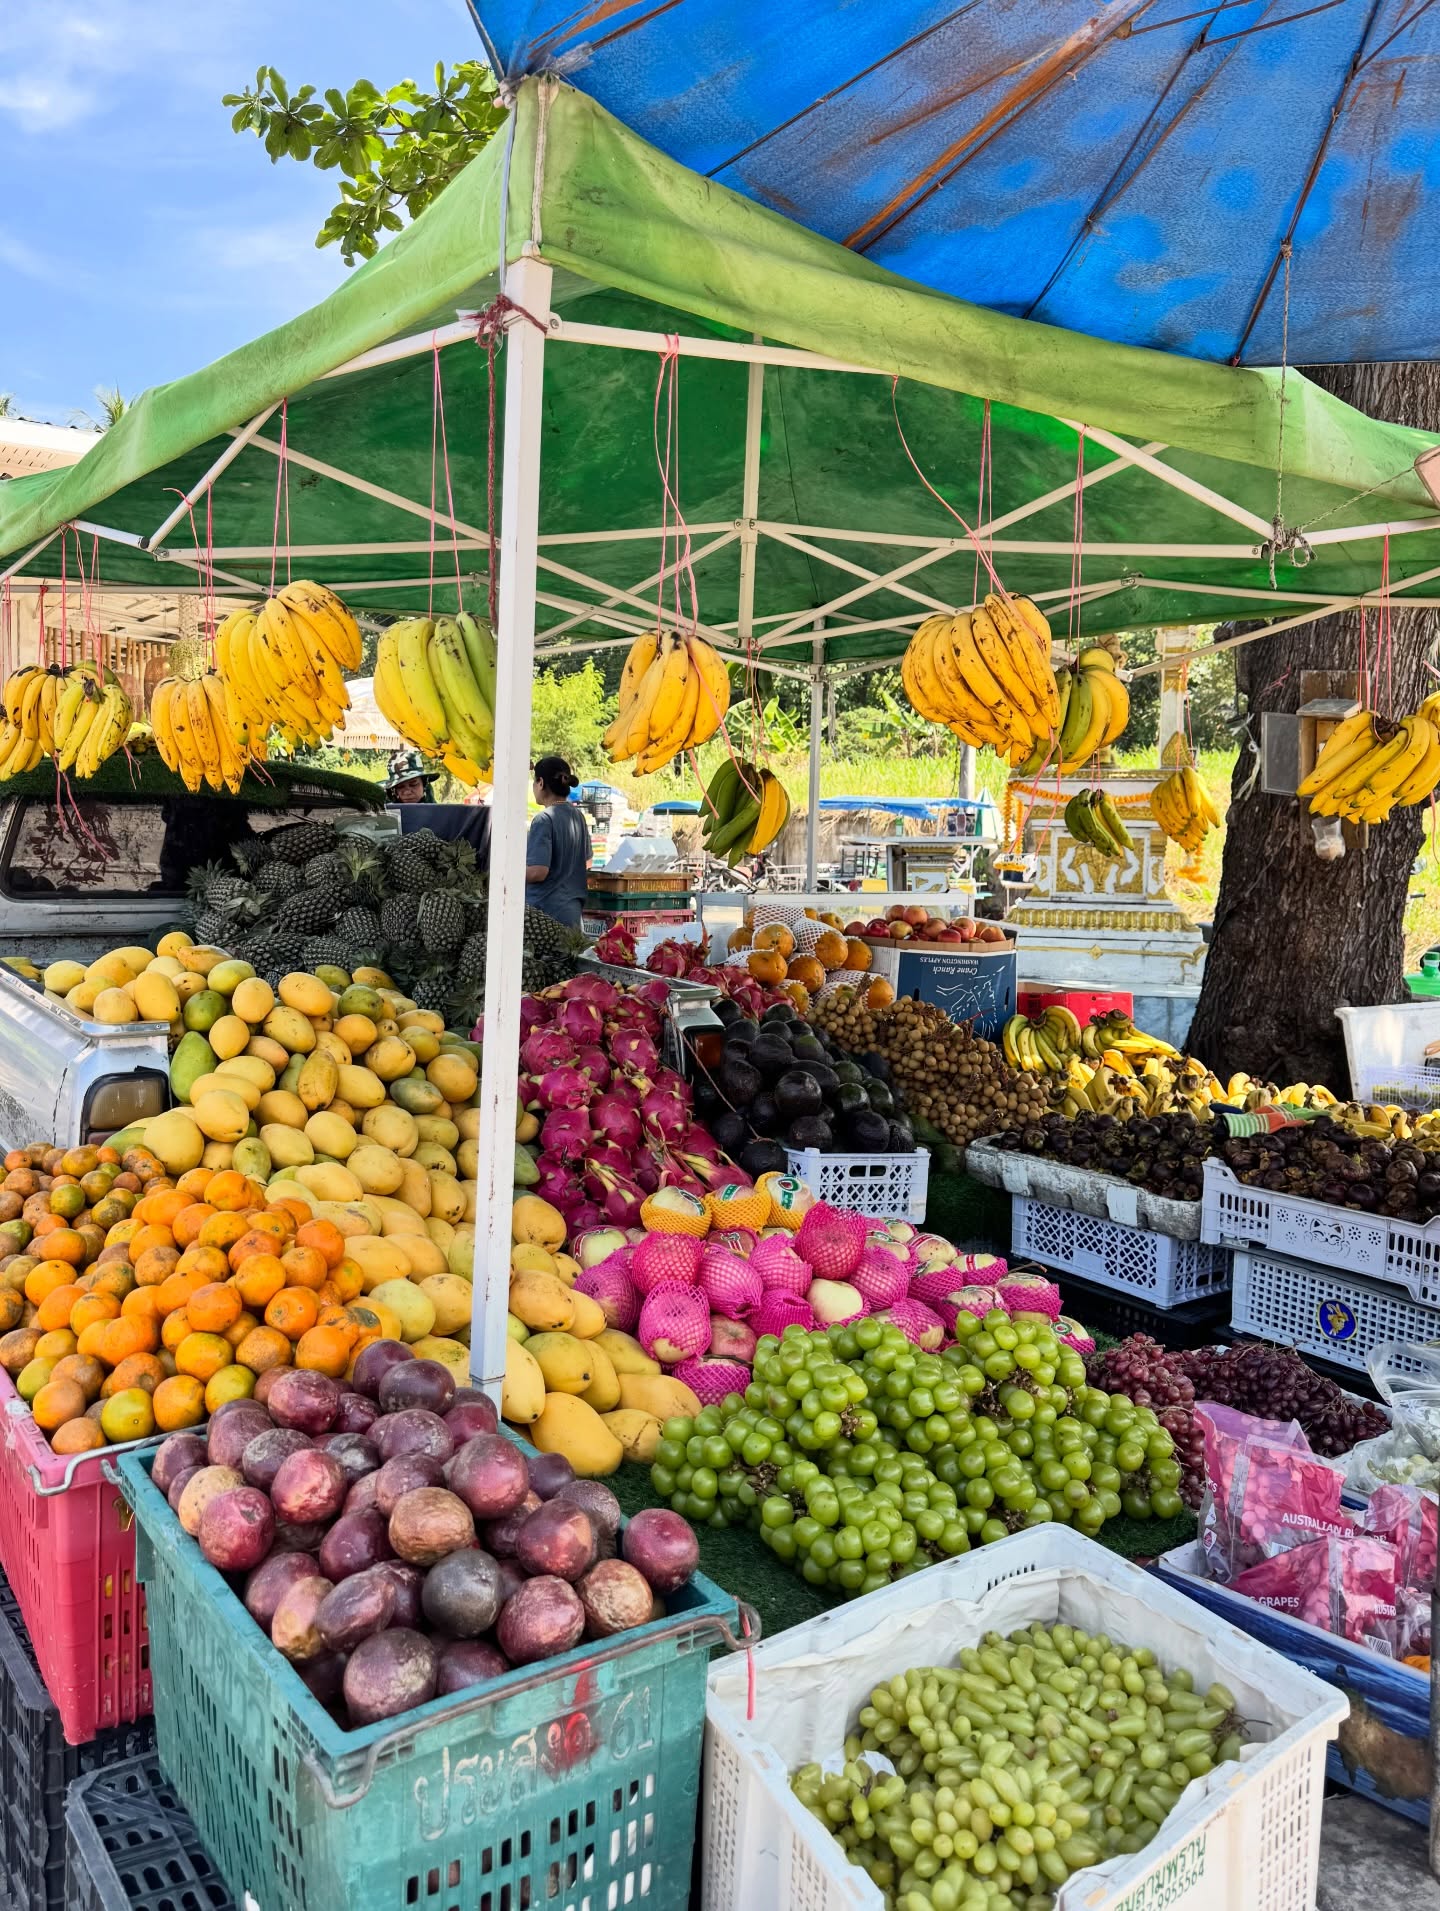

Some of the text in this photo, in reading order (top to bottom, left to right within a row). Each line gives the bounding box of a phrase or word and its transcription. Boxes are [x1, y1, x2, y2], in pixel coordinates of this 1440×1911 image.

[932, 966, 978, 975] Crane Ranch
[1281, 1512, 1341, 1536] AUSTRALIAN
[1258, 1596, 1300, 1608] GRAPES
